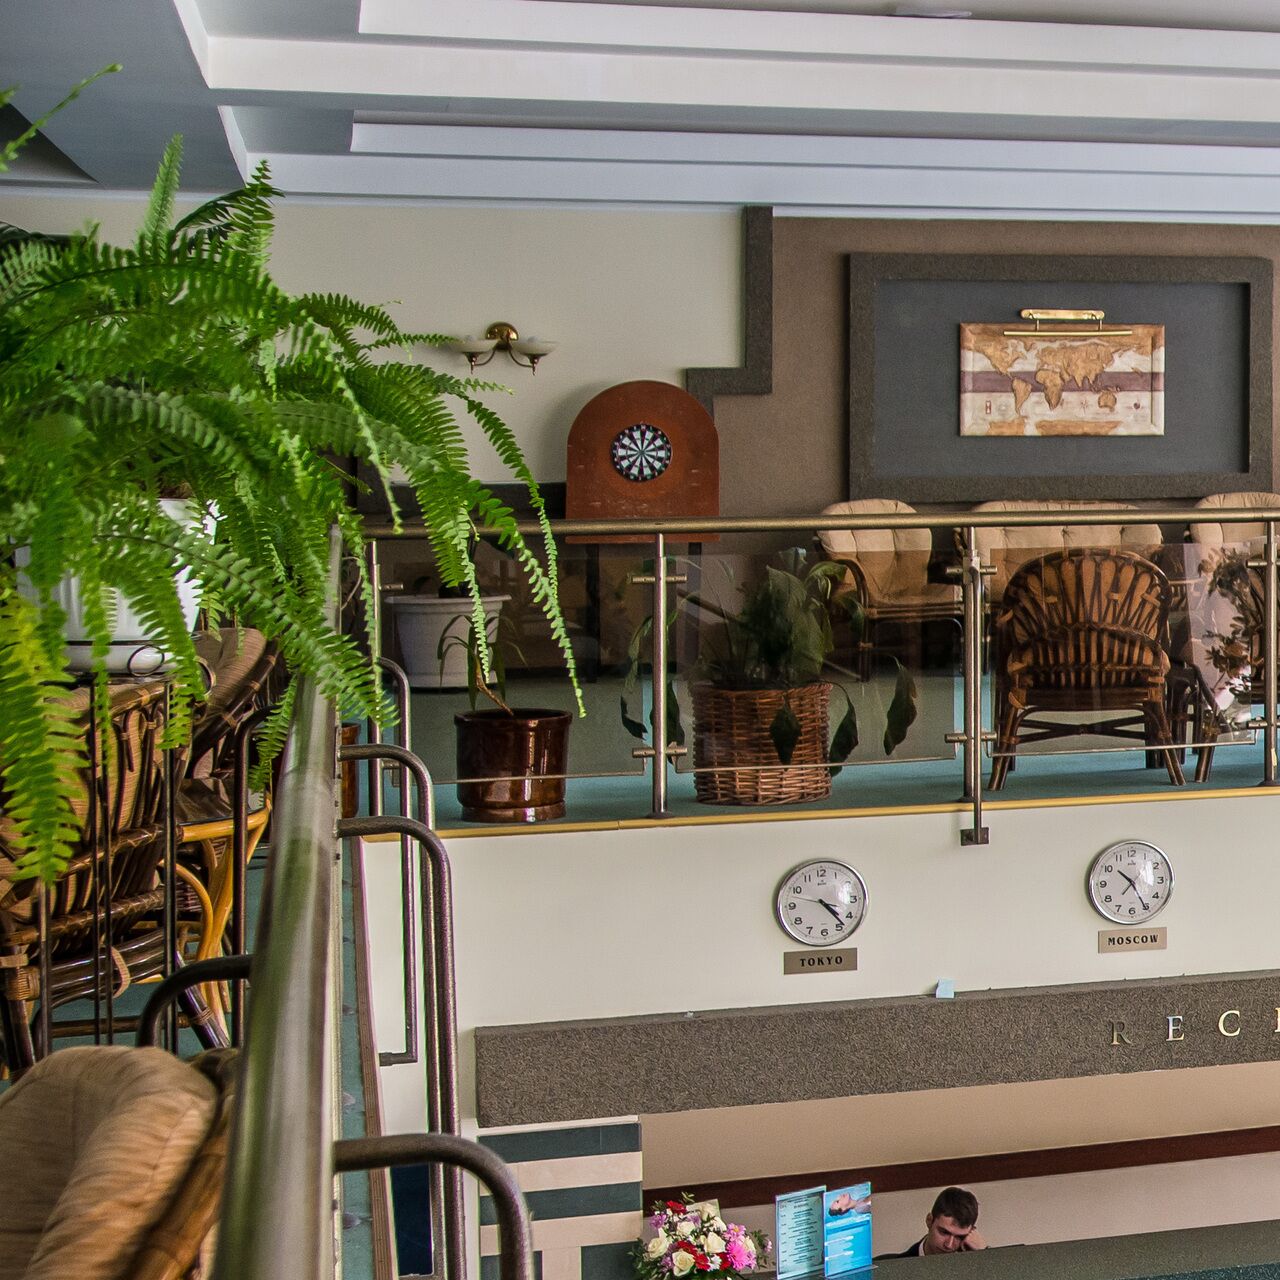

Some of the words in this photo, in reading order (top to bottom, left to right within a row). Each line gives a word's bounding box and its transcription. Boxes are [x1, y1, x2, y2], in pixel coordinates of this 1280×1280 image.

[1153, 862, 1159, 870] 2
[817, 869, 826, 877] 12
[804, 874, 811, 882] 11
[793, 886, 802, 894] 10
[850, 895, 857, 903] 3
[788, 902, 796, 910] 9
[1128, 907, 1136, 915] 6
[794, 917, 803, 925] 8
[806, 926, 813, 935] 7
[1107, 934, 1159, 946] MOSCOW
[799, 955, 843, 967] TOKYO
